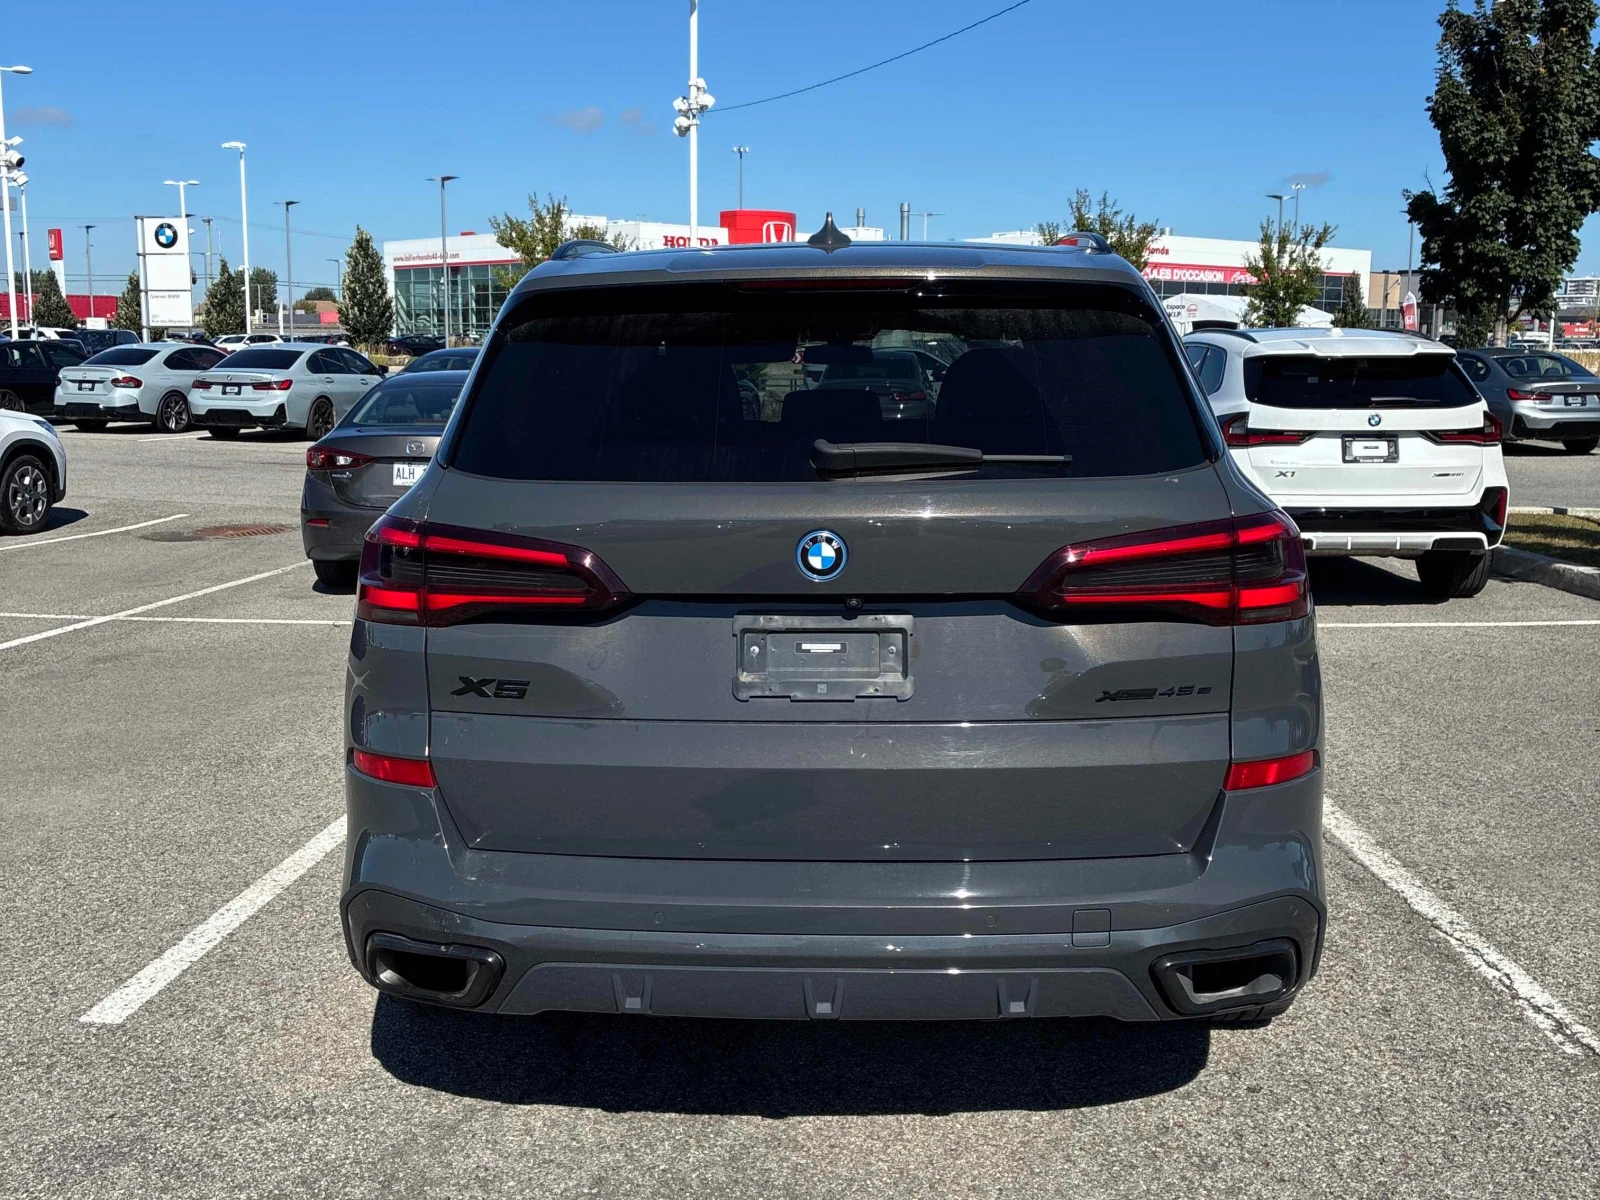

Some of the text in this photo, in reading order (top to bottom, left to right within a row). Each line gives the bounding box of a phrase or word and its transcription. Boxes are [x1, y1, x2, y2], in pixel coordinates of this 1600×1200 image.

[663, 236, 719, 248] HODA
[1173, 268, 1224, 281] D'OCCASION
[395, 467, 415, 480] ALH
[1274, 470, 1297, 478] X1
[450, 676, 532, 700] X5
